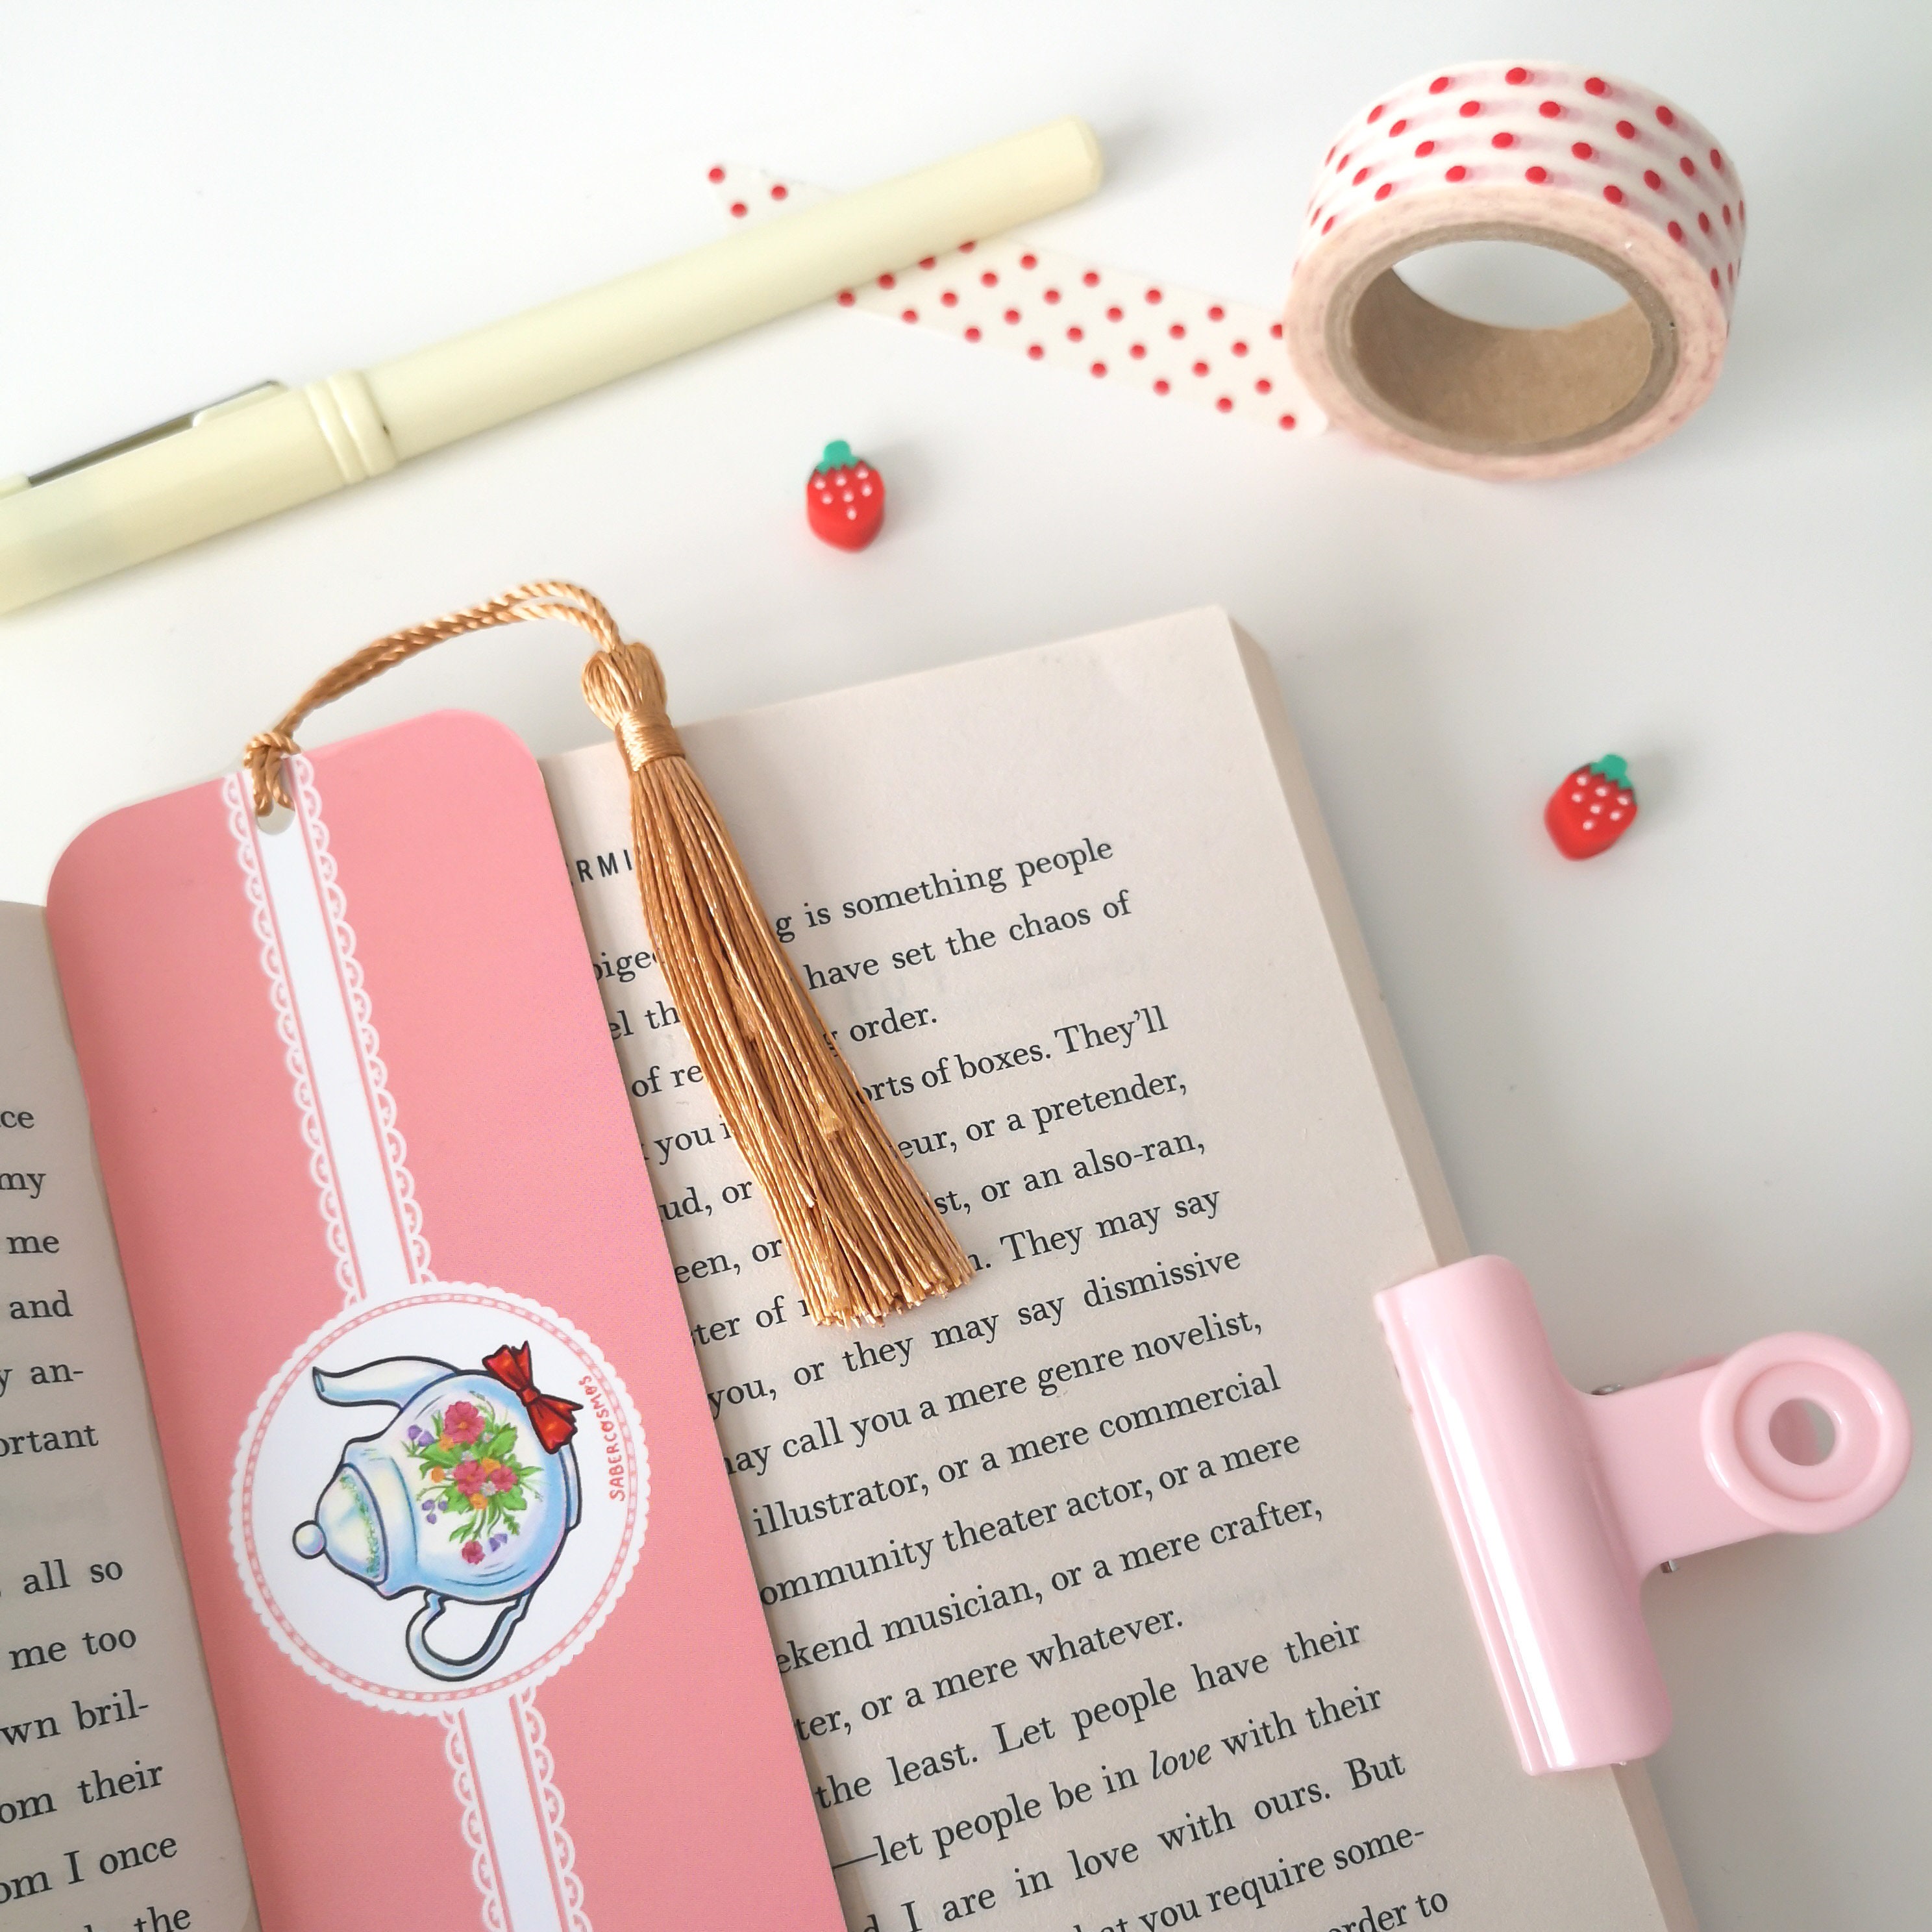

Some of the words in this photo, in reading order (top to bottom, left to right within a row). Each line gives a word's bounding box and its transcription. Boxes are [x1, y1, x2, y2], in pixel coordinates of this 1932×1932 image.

[567, 849, 633, 886] RMI
[804, 902, 830, 927] is
[843, 867, 1006, 919] something
[1015, 838, 1113, 887] people
[803, 959, 879, 990] have
[893, 943, 935, 969] set
[945, 928, 996, 956] the
[1009, 909, 1091, 941] chaos
[1103, 889, 1132, 919] of
[631, 1065, 662, 1097] of
[850, 1008, 936, 1041] order.
[0, 1111, 34, 1130] ce
[654, 1127, 715, 1165] you
[922, 1057, 952, 1088] of
[954, 1045, 1051, 1079] boxes.
[658, 1186, 712, 1222] ud,
[723, 1182, 752, 1204] or
[891, 1131, 957, 1159] eur,
[966, 1119, 995, 1141] or
[1007, 1114, 1026, 1131] a
[1032, 1073, 1186, 1135] pretender,
[6, 1236, 59, 1254] me
[752, 1239, 781, 1261] or
[933, 1191, 971, 1215] st,
[982, 1180, 1010, 1202] or
[1024, 1169, 1063, 1191] an
[1074, 1135, 1204, 1179] also-ran,
[10, 1290, 73, 1319] and
[691, 1317, 741, 1341] ter
[756, 1295, 787, 1328] of
[1000, 1227, 1083, 1261] They
[1095, 1207, 1160, 1238] may
[1175, 1191, 1220, 1219] say
[31, 1365, 83, 1384] an-
[707, 1380, 776, 1421] you,
[794, 1363, 824, 1385] or
[842, 1337, 913, 1371] they
[930, 1315, 998, 1348] may
[1018, 1297, 1064, 1326] say
[1084, 1252, 1240, 1307] dismissive
[783, 1417, 844, 1457] call
[850, 1408, 911, 1448] you
[920, 1401, 939, 1419] a
[945, 1376, 1026, 1413] mere
[1038, 1350, 1124, 1393] genre
[1132, 1312, 1261, 1361] novelist,
[753, 1474, 928, 1537] illustrator,
[939, 1459, 968, 1482] or
[981, 1453, 1000, 1471] a
[1007, 1428, 1089, 1464] mere
[1100, 1365, 1281, 1437] commercial
[943, 1504, 1056, 1552] theater
[1067, 1480, 1152, 1516] actor,
[1159, 1466, 1188, 1489] or
[1198, 1460, 1217, 1478] a
[1220, 1436, 1300, 1472] mere
[23, 1559, 71, 1594] all
[90, 1562, 123, 1583] so
[881, 1583, 1042, 1642] musician,
[1052, 1567, 1081, 1591] or
[1093, 1560, 1113, 1579] a
[1119, 1533, 1200, 1572] mere
[1211, 1500, 1322, 1544] crafter,
[8, 1642, 66, 1670] me
[82, 1629, 136, 1655] too
[861, 1696, 892, 1720] or
[906, 1688, 925, 1707] a
[932, 1659, 1017, 1700] mere
[1026, 1611, 1182, 1669] whatever.
[71, 1689, 149, 1729] bril-
[814, 1774, 872, 1809] the
[886, 1744, 977, 1786] least.
[991, 1718, 1055, 1754] Let
[1071, 1678, 1176, 1741] people
[1191, 1655, 1269, 1692] have
[1284, 1621, 1359, 1663] their
[77, 1761, 162, 1803] their
[932, 1793, 1041, 1859] people
[1049, 1781, 1092, 1810] be
[1102, 1766, 1139, 1794] in
[1150, 1744, 1211, 1779] love
[1220, 1711, 1296, 1755] with
[1306, 1686, 1380, 1729] their
[64, 1850, 84, 1884] I
[100, 1838, 177, 1874] once
[901, 1901, 923, 1932] I
[943, 1889, 995, 1922] are
[1015, 1868, 1054, 1898] in
[1067, 1843, 1138, 1879] love
[1158, 1805, 1235, 1850] with
[1255, 1784, 1330, 1820] ours.
[1344, 1753, 1405, 1790] But
[1139, 1900, 1202, 1932] you
[1206, 1858, 1325, 1912] require
[1333, 1829, 1424, 1870] some-
[133, 1906, 191, 1932] the
[1415, 1894, 1448, 1917] to
